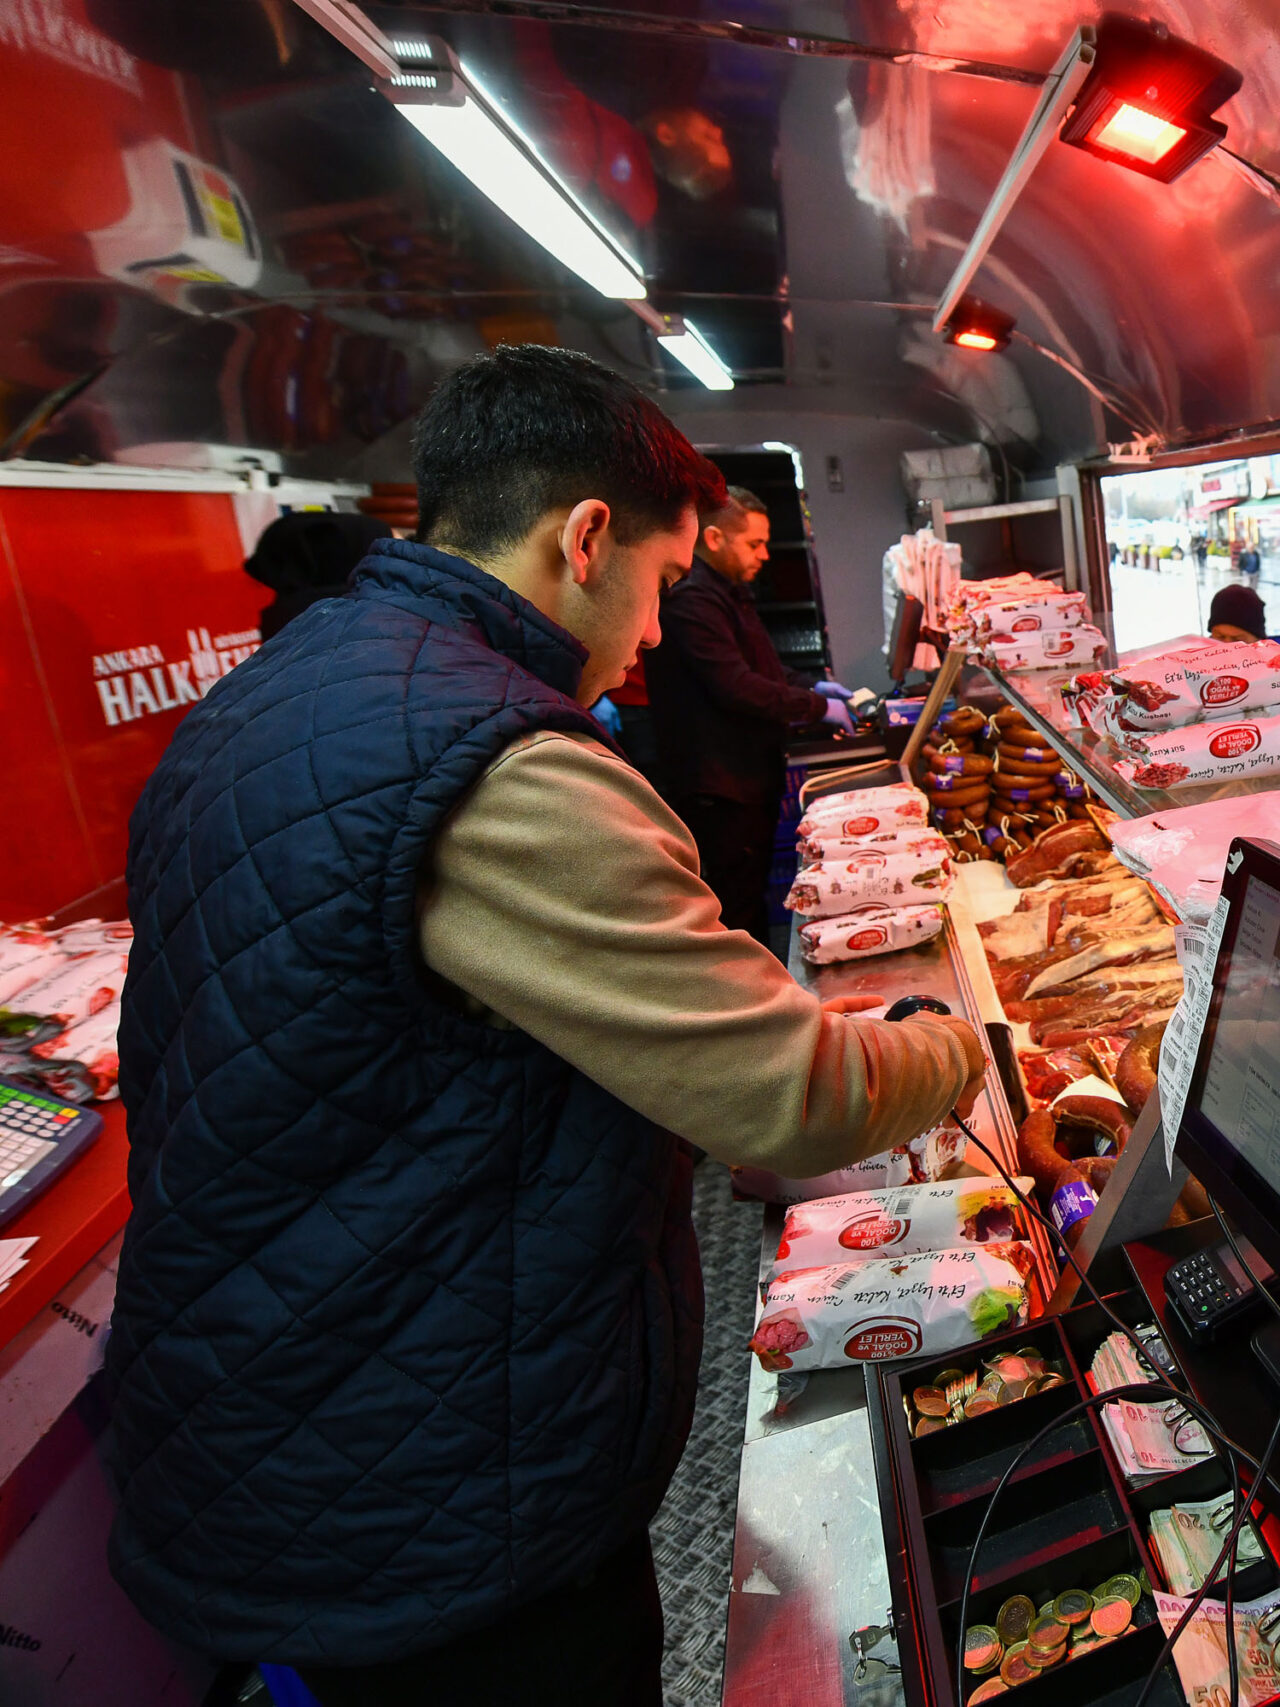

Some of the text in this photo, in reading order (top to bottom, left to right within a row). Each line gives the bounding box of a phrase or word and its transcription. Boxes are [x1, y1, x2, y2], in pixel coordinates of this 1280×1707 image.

[92, 643, 165, 677] ANKARA
[95, 660, 201, 726] HALK
[1174, 744, 1186, 752] Süt
[1216, 762, 1245, 773] Kalite,
[858, 1160, 888, 1172] Güven
[929, 1189, 954, 1198] Et'te
[950, 1251, 976, 1262] Et'te
[854, 1290, 891, 1305] Kalite
[898, 1281, 933, 1303] Lezzet,
[938, 1284, 966, 1299] Et'te
[50, 1301, 99, 1338] Nitto
[859, 1334, 905, 1344] YERLİ ET
[871, 1341, 908, 1351] DOĞAL
[871, 1350, 897, 1359] %100
[1126, 1405, 1148, 1422] 10
